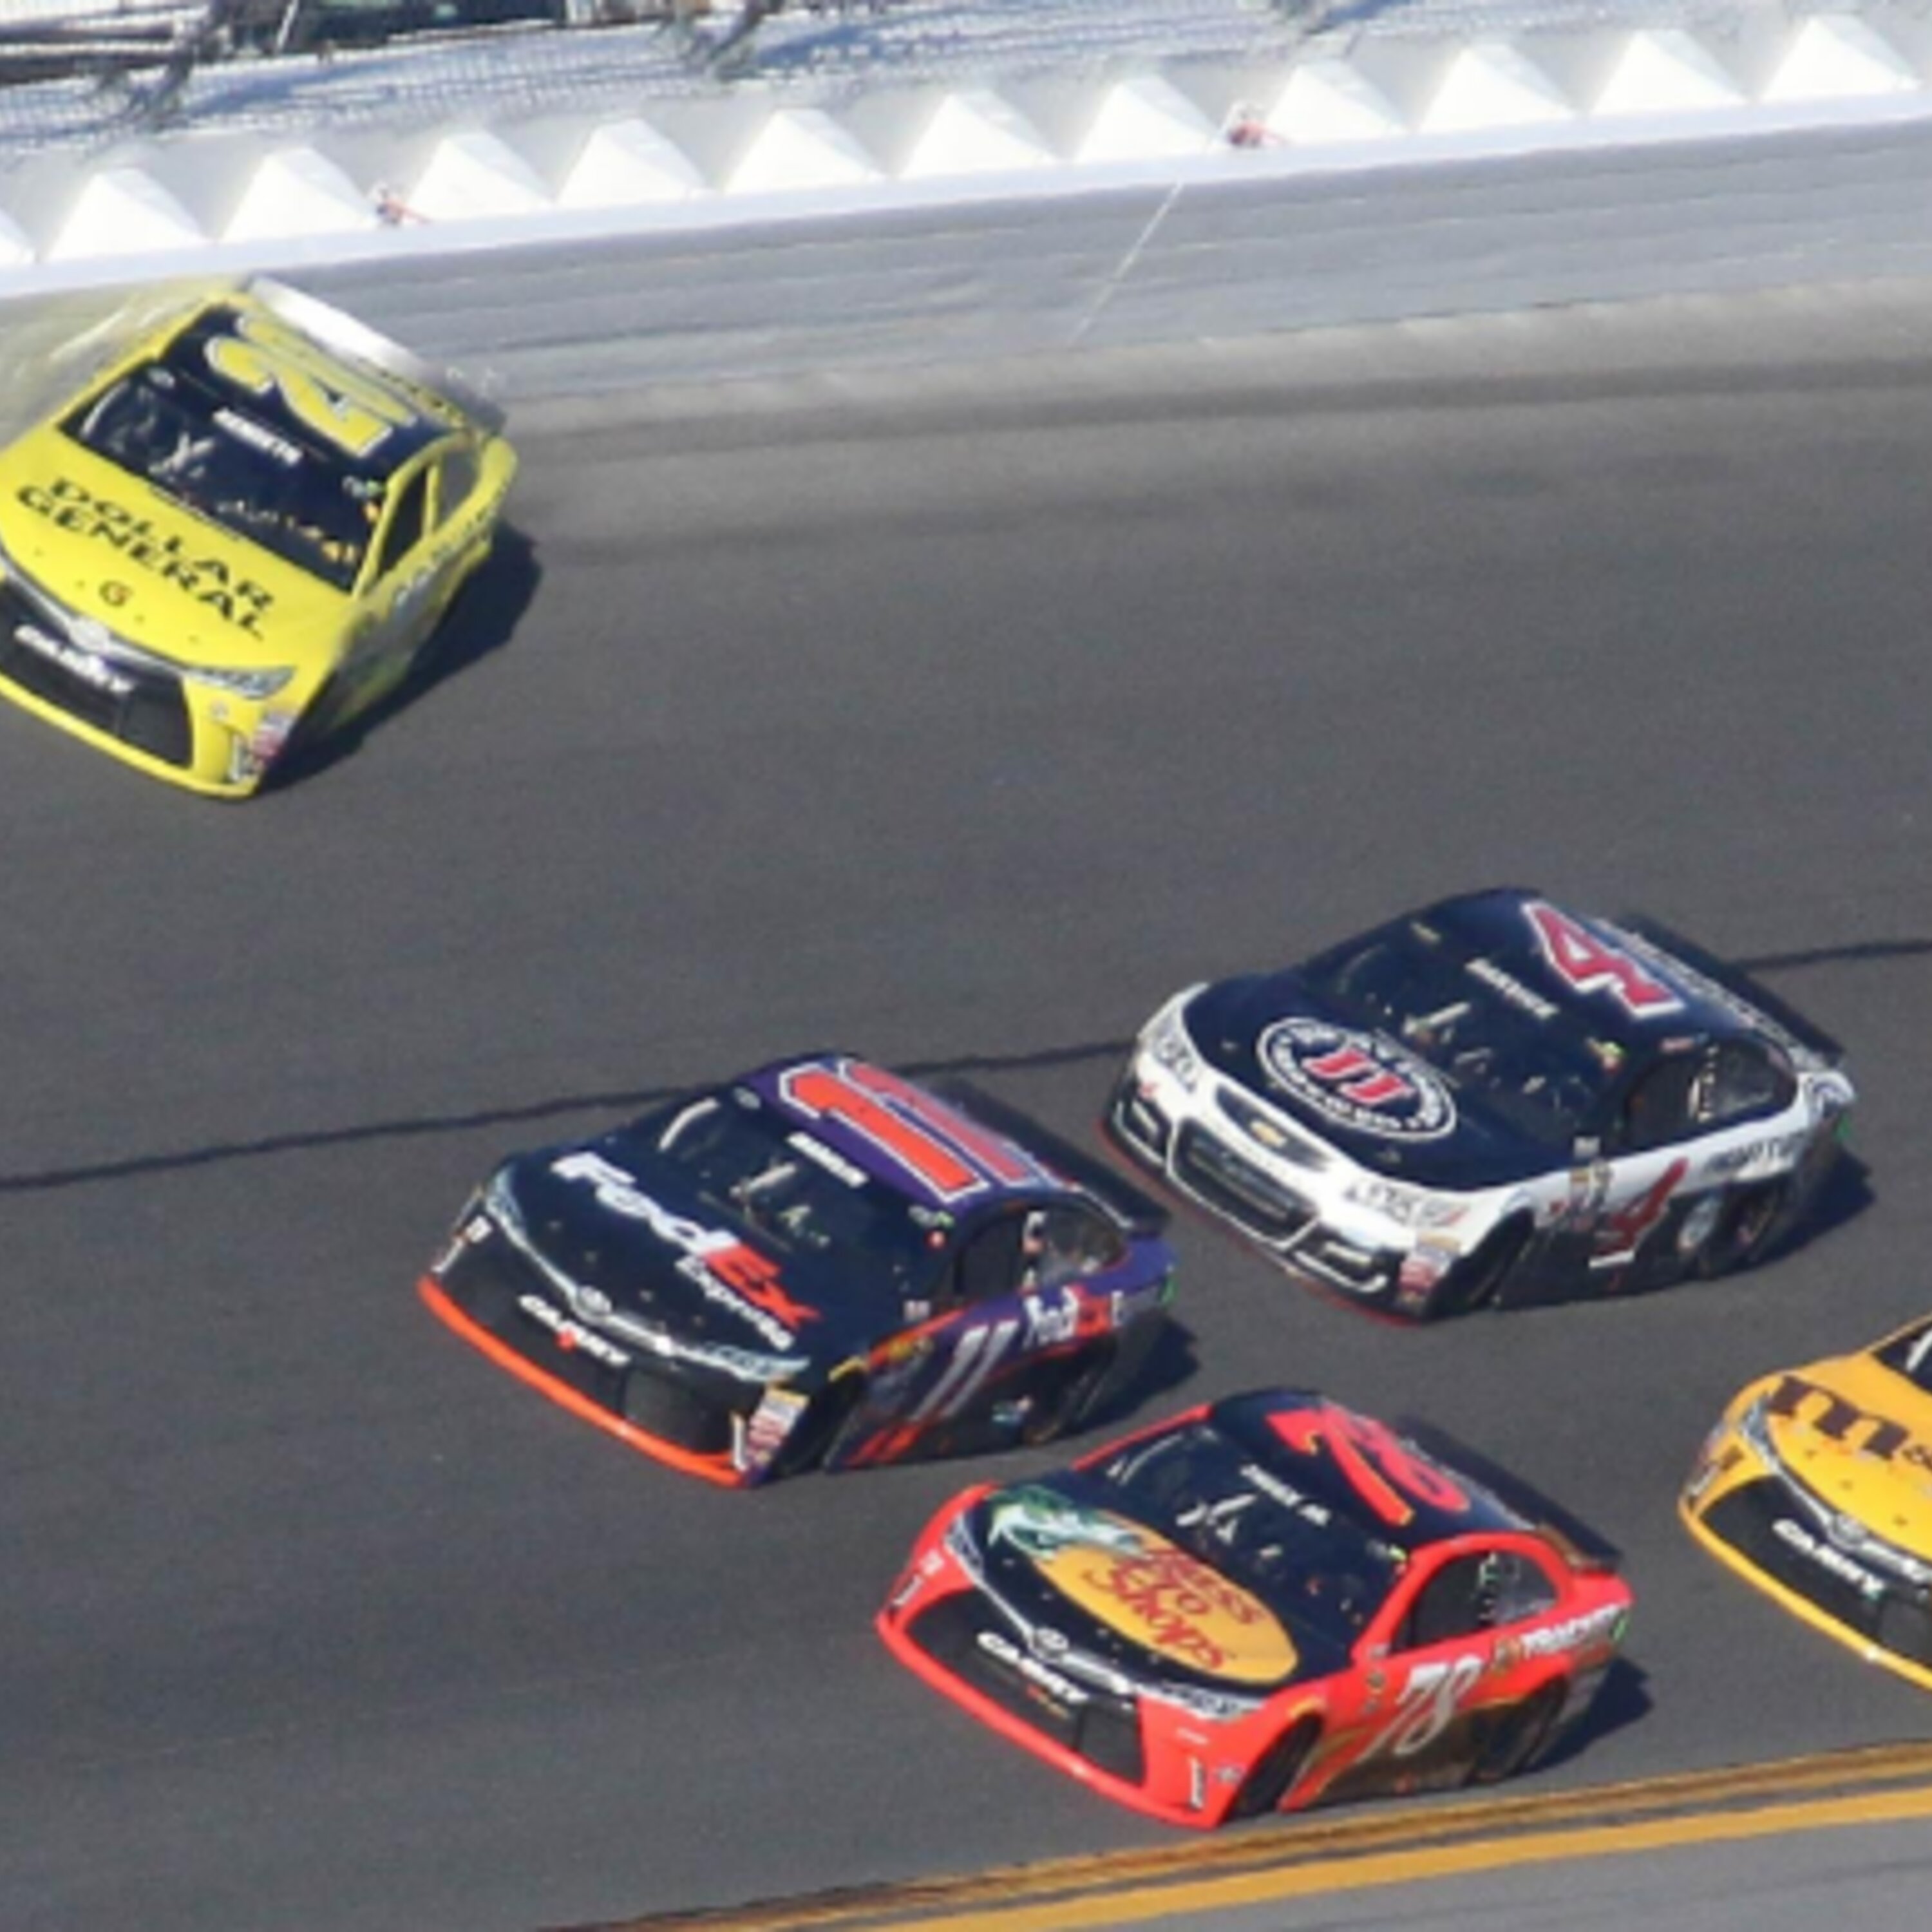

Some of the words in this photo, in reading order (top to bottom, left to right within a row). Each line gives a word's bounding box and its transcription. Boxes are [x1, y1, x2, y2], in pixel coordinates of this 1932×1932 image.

[15, 485, 263, 641] GENERAL
[50, 478, 274, 609] DOLLAR
[1522, 900, 1685, 1018] 4
[551, 1151, 822, 1332] FedEx
